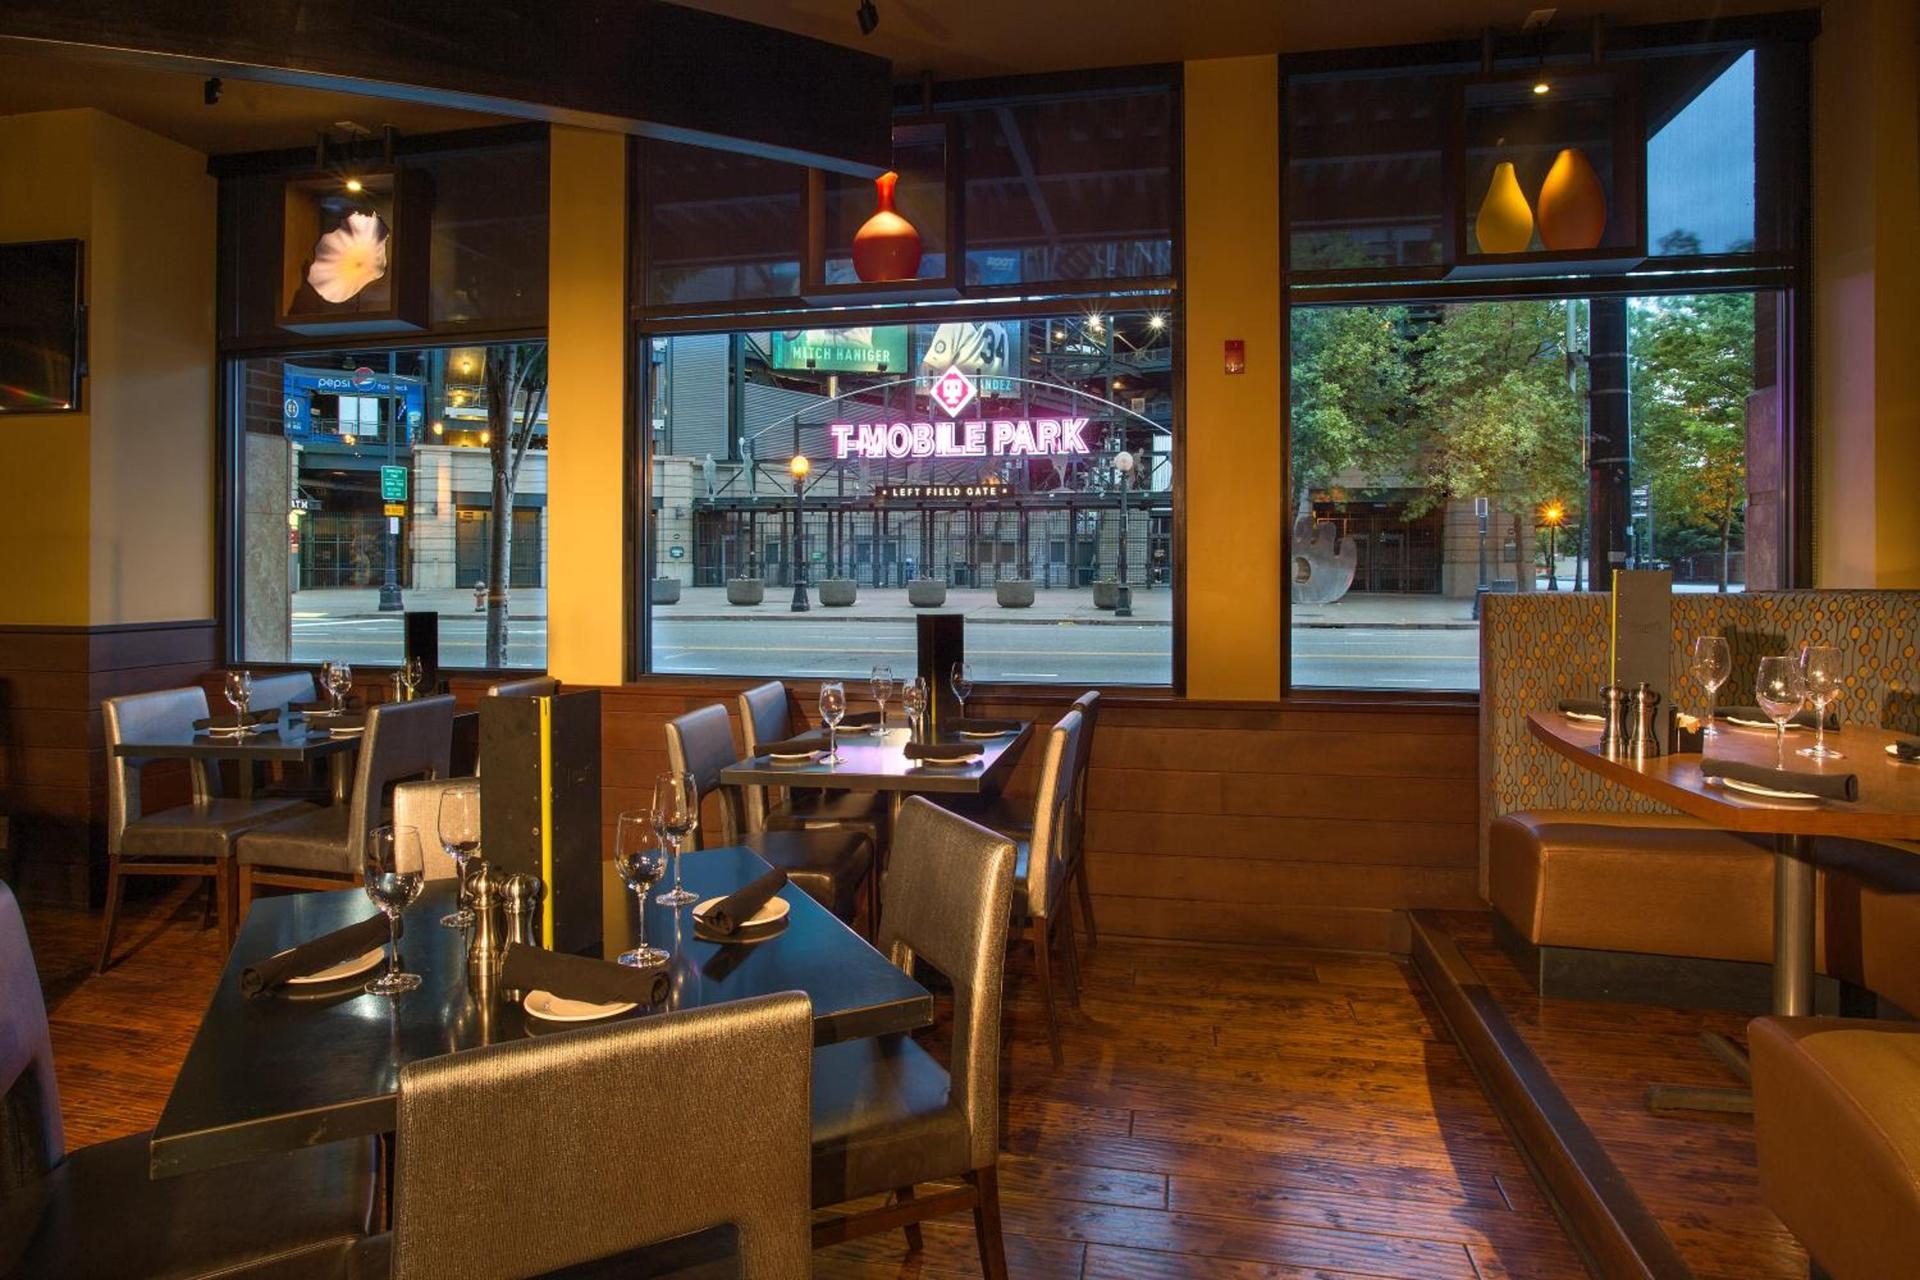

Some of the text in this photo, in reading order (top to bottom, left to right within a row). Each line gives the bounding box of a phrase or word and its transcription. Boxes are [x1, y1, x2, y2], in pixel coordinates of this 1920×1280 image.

[793, 346, 890, 362] MITCH HANIGER
[979, 328, 1005, 367] 34
[318, 378, 350, 389] pepsi
[831, 418, 1090, 459] T-MOBILE PARK
[893, 487, 996, 496] LEFT FIELD GATE
